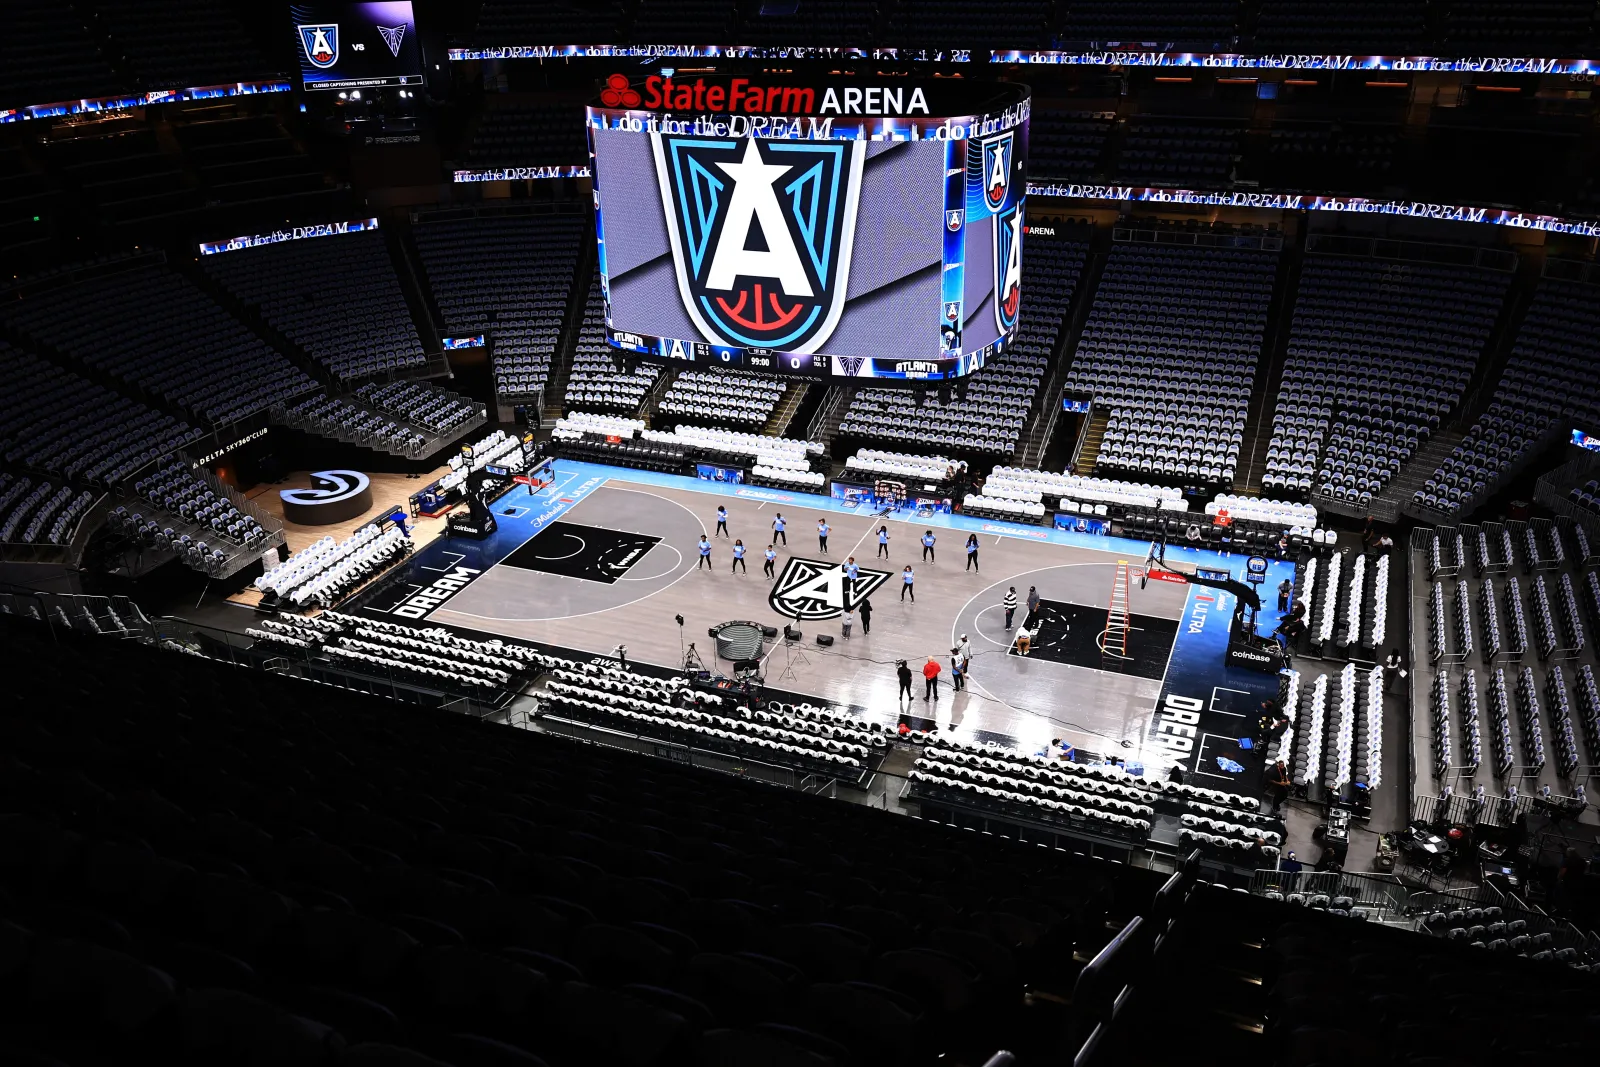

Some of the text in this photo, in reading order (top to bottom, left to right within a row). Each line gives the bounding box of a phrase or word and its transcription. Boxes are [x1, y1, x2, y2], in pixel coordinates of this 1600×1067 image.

[587, 46, 600, 56] do
[602, 46, 610, 56] it
[612, 45, 627, 56] for
[647, 45, 695, 57] DREAM
[1031, 52, 1046, 63] do
[1049, 52, 1058, 63] it
[1060, 52, 1078, 64] for
[1101, 52, 1166, 66] DREAM
[1204, 54, 1221, 66] do
[1225, 54, 1234, 66] it
[1236, 55, 1256, 67] for
[1282, 55, 1352, 69] DREAM
[1394, 57, 1413, 70] do
[1416, 57, 1427, 70] it
[1430, 57, 1451, 70] for
[1480, 57, 1558, 73] DREAM
[645, 75, 930, 114] State Farm ARENA
[620, 112, 835, 140] do it for the DREAM
[935, 119, 965, 141] do
[968, 117, 980, 138] it
[980, 113, 1000, 136] for
[1068, 184, 1133, 200] DREAM
[1154, 190, 1171, 202] do
[1175, 191, 1184, 203] it
[1186, 190, 1207, 204] for
[1232, 192, 1303, 209] DREAM
[1325, 198, 1344, 211] do
[1348, 199, 1358, 212] it
[1360, 199, 1383, 213] for
[1409, 202, 1488, 222] DREAM
[1029, 226, 1055, 236] ARENA
[1511, 213, 1531, 228] do
[1534, 216, 1546, 230] it
[1547, 217, 1572, 233] for
[227, 239, 242, 251] do
[254, 234, 271, 247] for
[292, 222, 349, 240] DREAM
[613, 332, 643, 347] ATLANTA
[721, 350, 731, 362] 0
[751, 357, 770, 367] 99:00
[790, 357, 801, 369] 0
[896, 361, 938, 373] ATLANTA
[200, 449, 225, 466] DELTA
[568, 477, 604, 498] ULTRA
[530, 503, 566, 528] Michelob
[453, 525, 478, 534] coinbase
[392, 566, 481, 619] DREAM
[1187, 602, 1209, 634] ULTRA
[1232, 650, 1271, 663] coinbase
